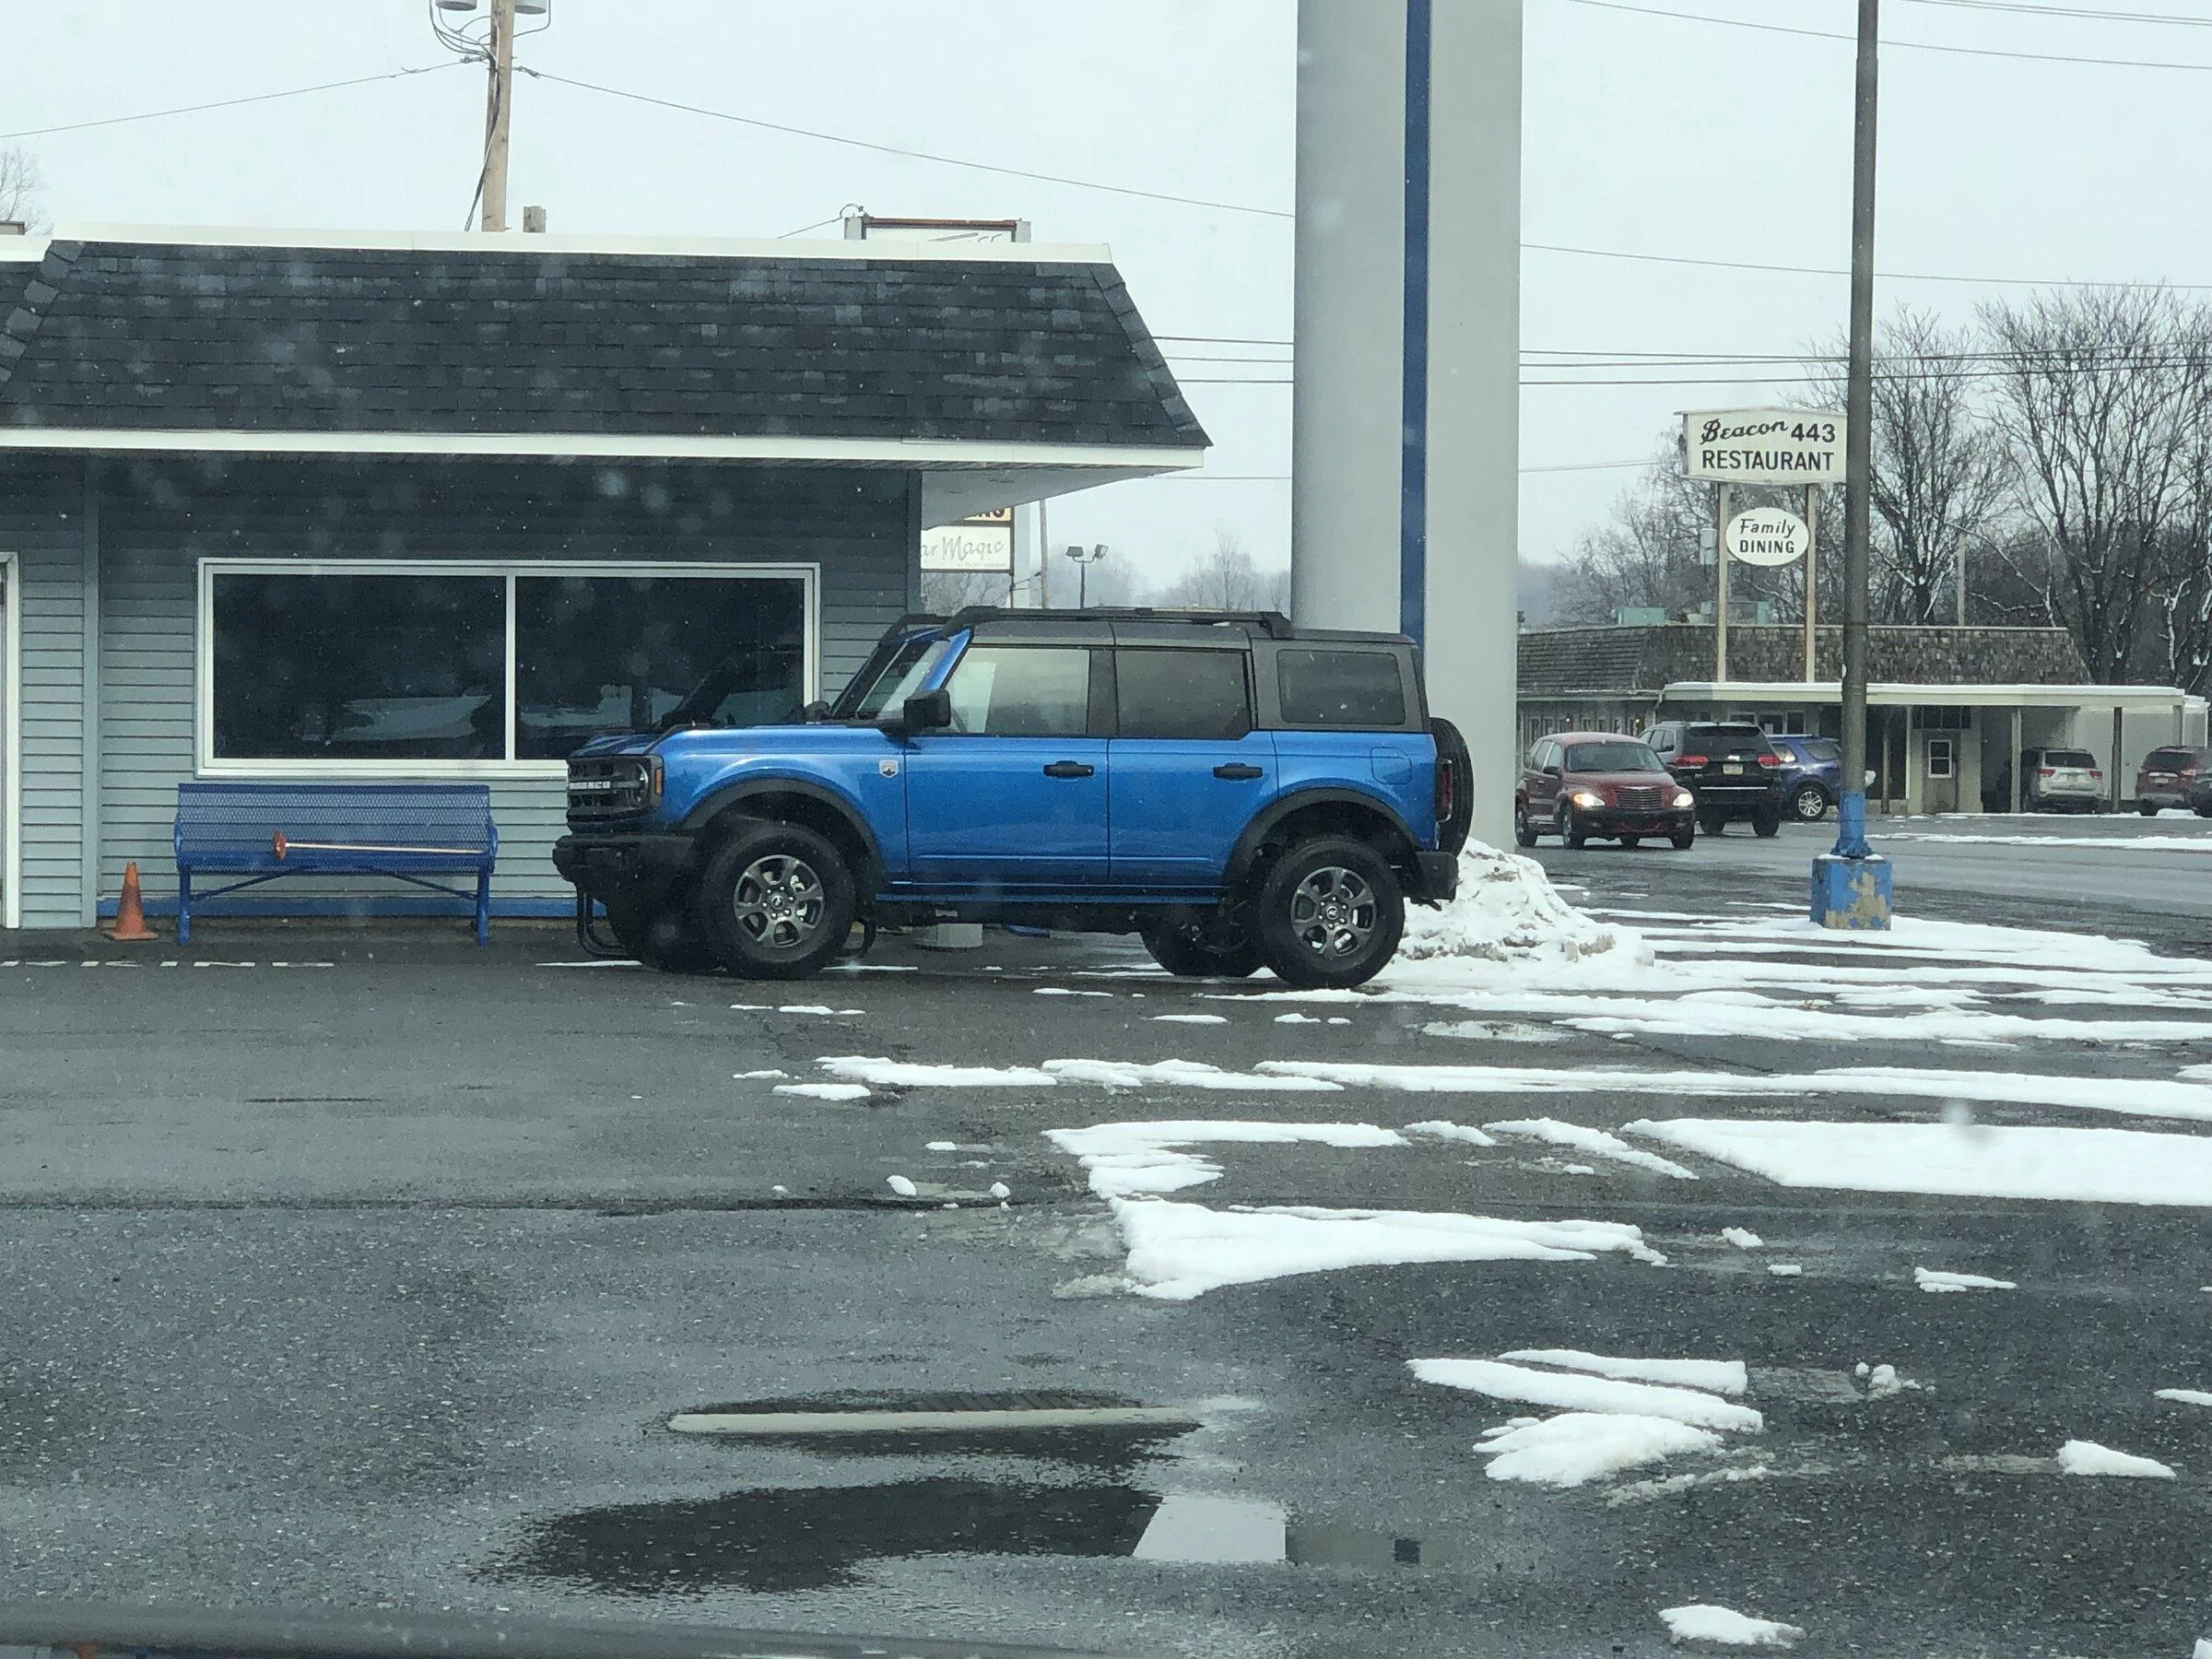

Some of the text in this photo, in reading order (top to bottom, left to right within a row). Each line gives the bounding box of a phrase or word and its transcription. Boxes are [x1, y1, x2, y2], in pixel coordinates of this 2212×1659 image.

[1700, 418, 1836, 445] Beacon 443
[1702, 450, 1834, 471] RESTAURANT
[1740, 518, 1795, 538] Family
[942, 535, 1004, 561] Magic
[1739, 540, 1794, 553] DINING
